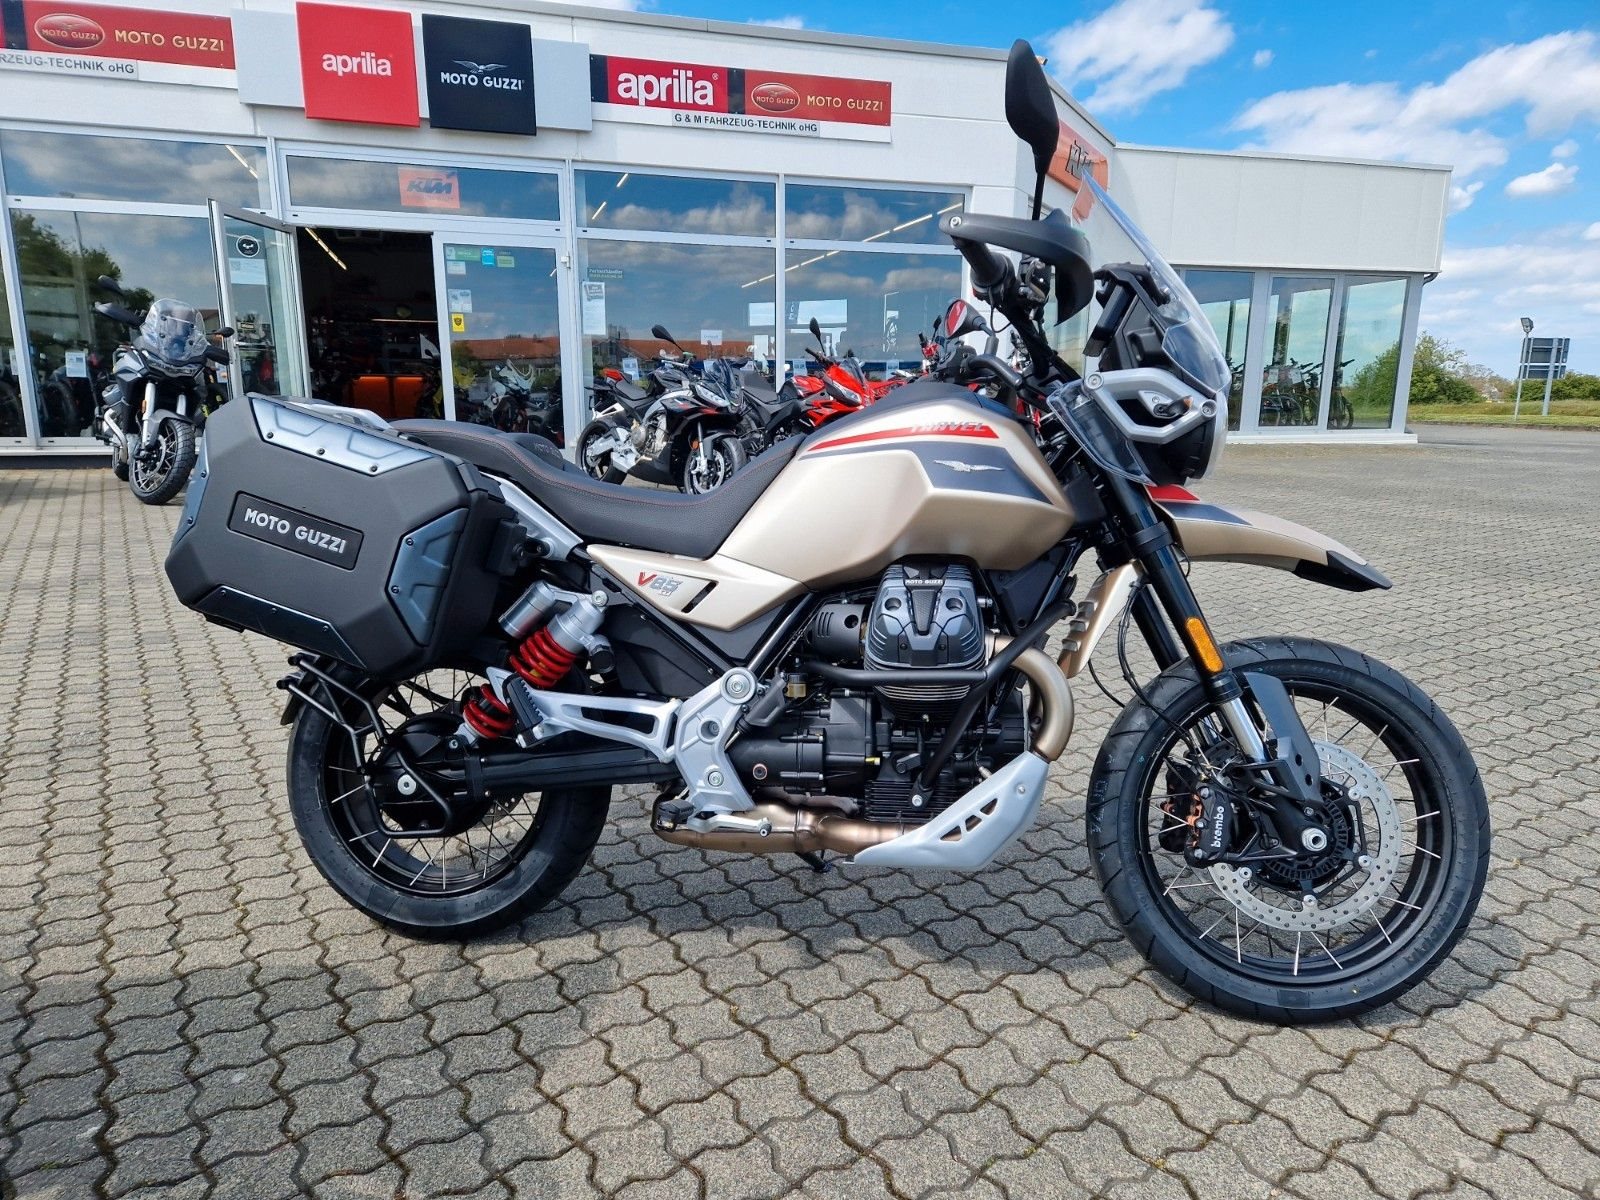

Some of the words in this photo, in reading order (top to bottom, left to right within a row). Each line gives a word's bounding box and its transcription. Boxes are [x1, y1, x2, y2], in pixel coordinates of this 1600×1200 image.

[41, 28, 68, 38] MOTO
[71, 31, 99, 41] GUZZI
[114, 29, 165, 47] MOTO
[172, 36, 225, 52] GUZZI
[108, 63, 135, 74] oHG
[322, 51, 393, 77] aprilia
[441, 72, 479, 86] MOTO
[483, 76, 523, 91] GUZZI
[617, 68, 714, 107] aprilia
[756, 96, 774, 104] MOTO
[776, 97, 796, 105] GUZZI
[807, 95, 842, 108] MOTO
[847, 98, 883, 111] GUZZI
[674, 113, 682, 122] G
[684, 114, 691, 123] &
[693, 115, 702, 124] M
[704, 116, 797, 131] FAHRZEUG-TECHNIK
[798, 122, 818, 132] oHG
[407, 177, 453, 194] KTM
[244, 507, 291, 534] MOTO
[294, 525, 347, 554] GUZZI
[1210, 805, 1225, 848] brembo
